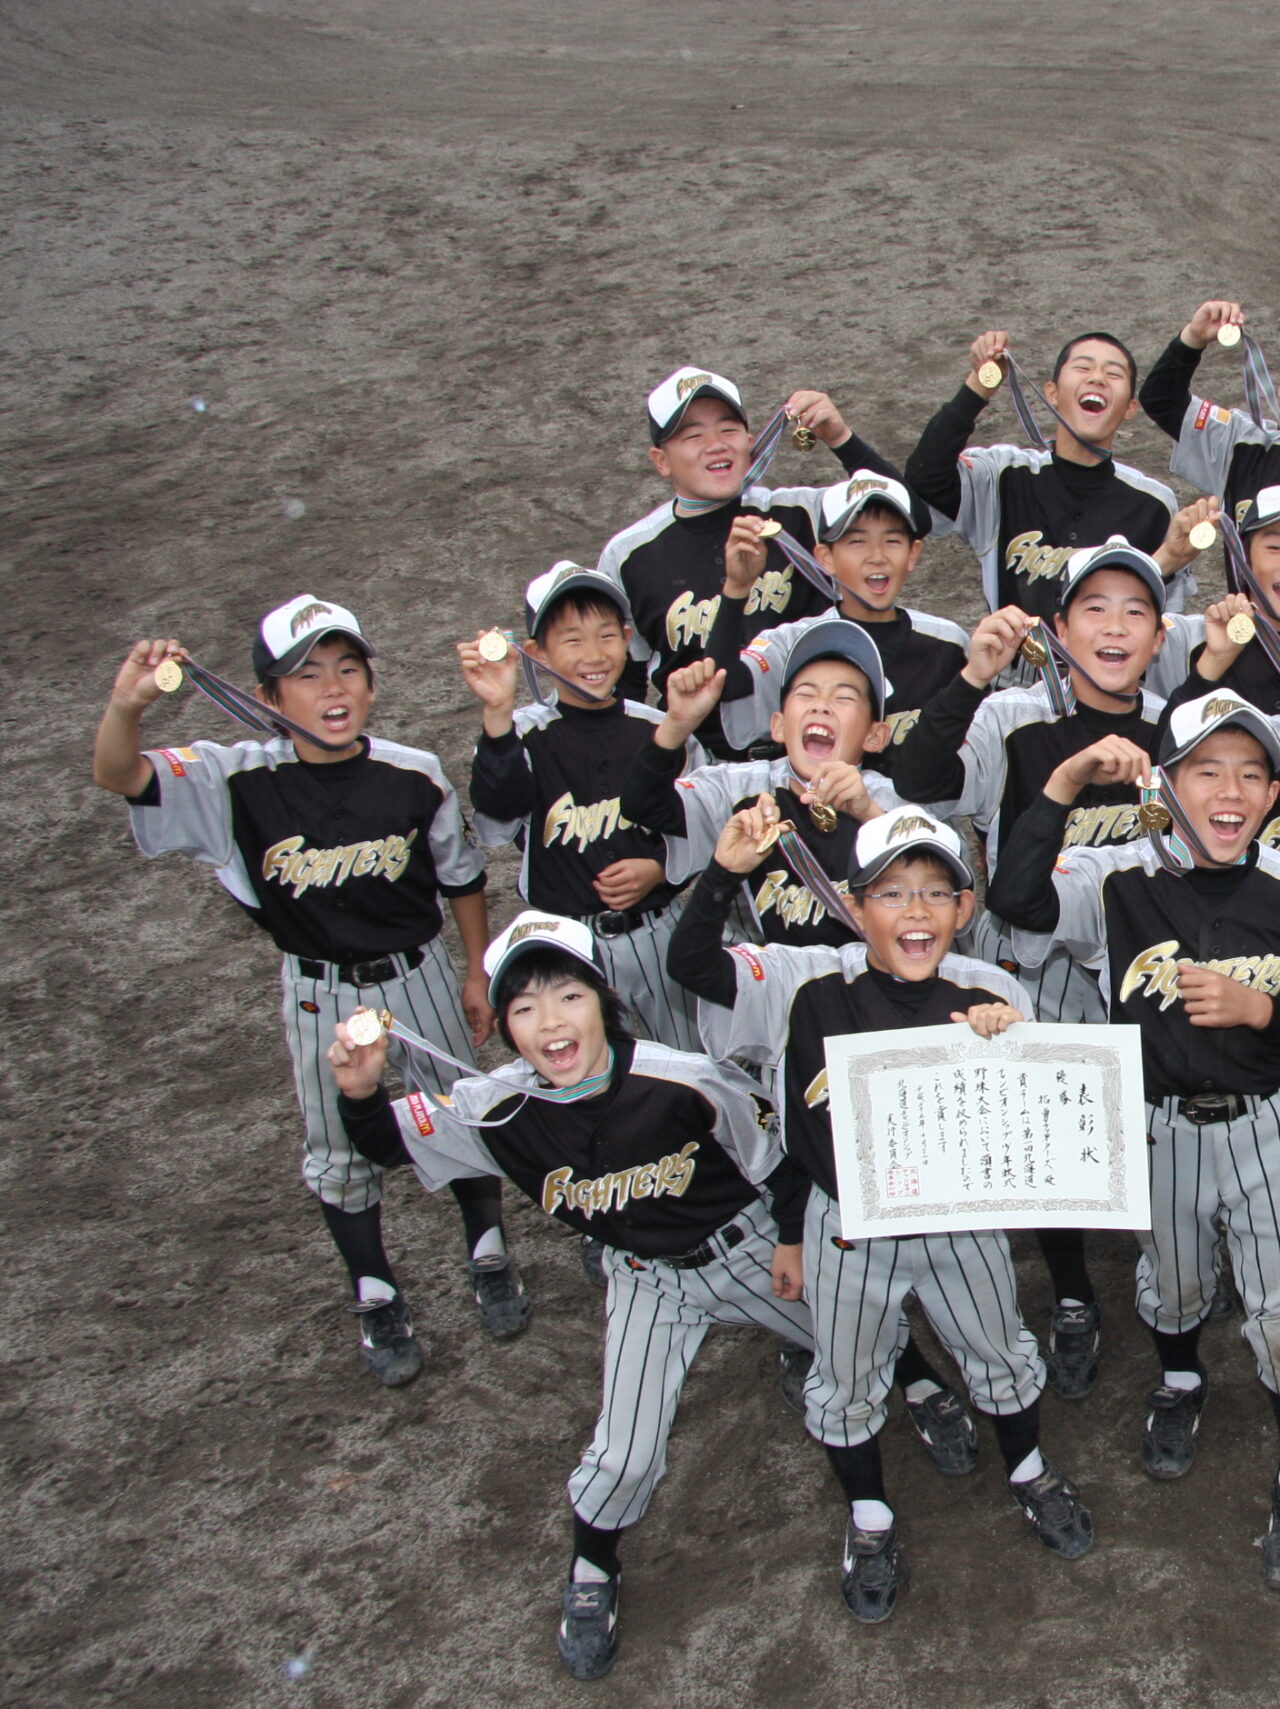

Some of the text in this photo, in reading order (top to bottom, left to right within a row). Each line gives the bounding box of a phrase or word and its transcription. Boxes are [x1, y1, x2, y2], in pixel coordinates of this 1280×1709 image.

[262, 828, 418, 898] FIGHTERS
[1077, 1083, 1100, 1164] 表彰状
[541, 1141, 701, 1216] FIGHTERS
